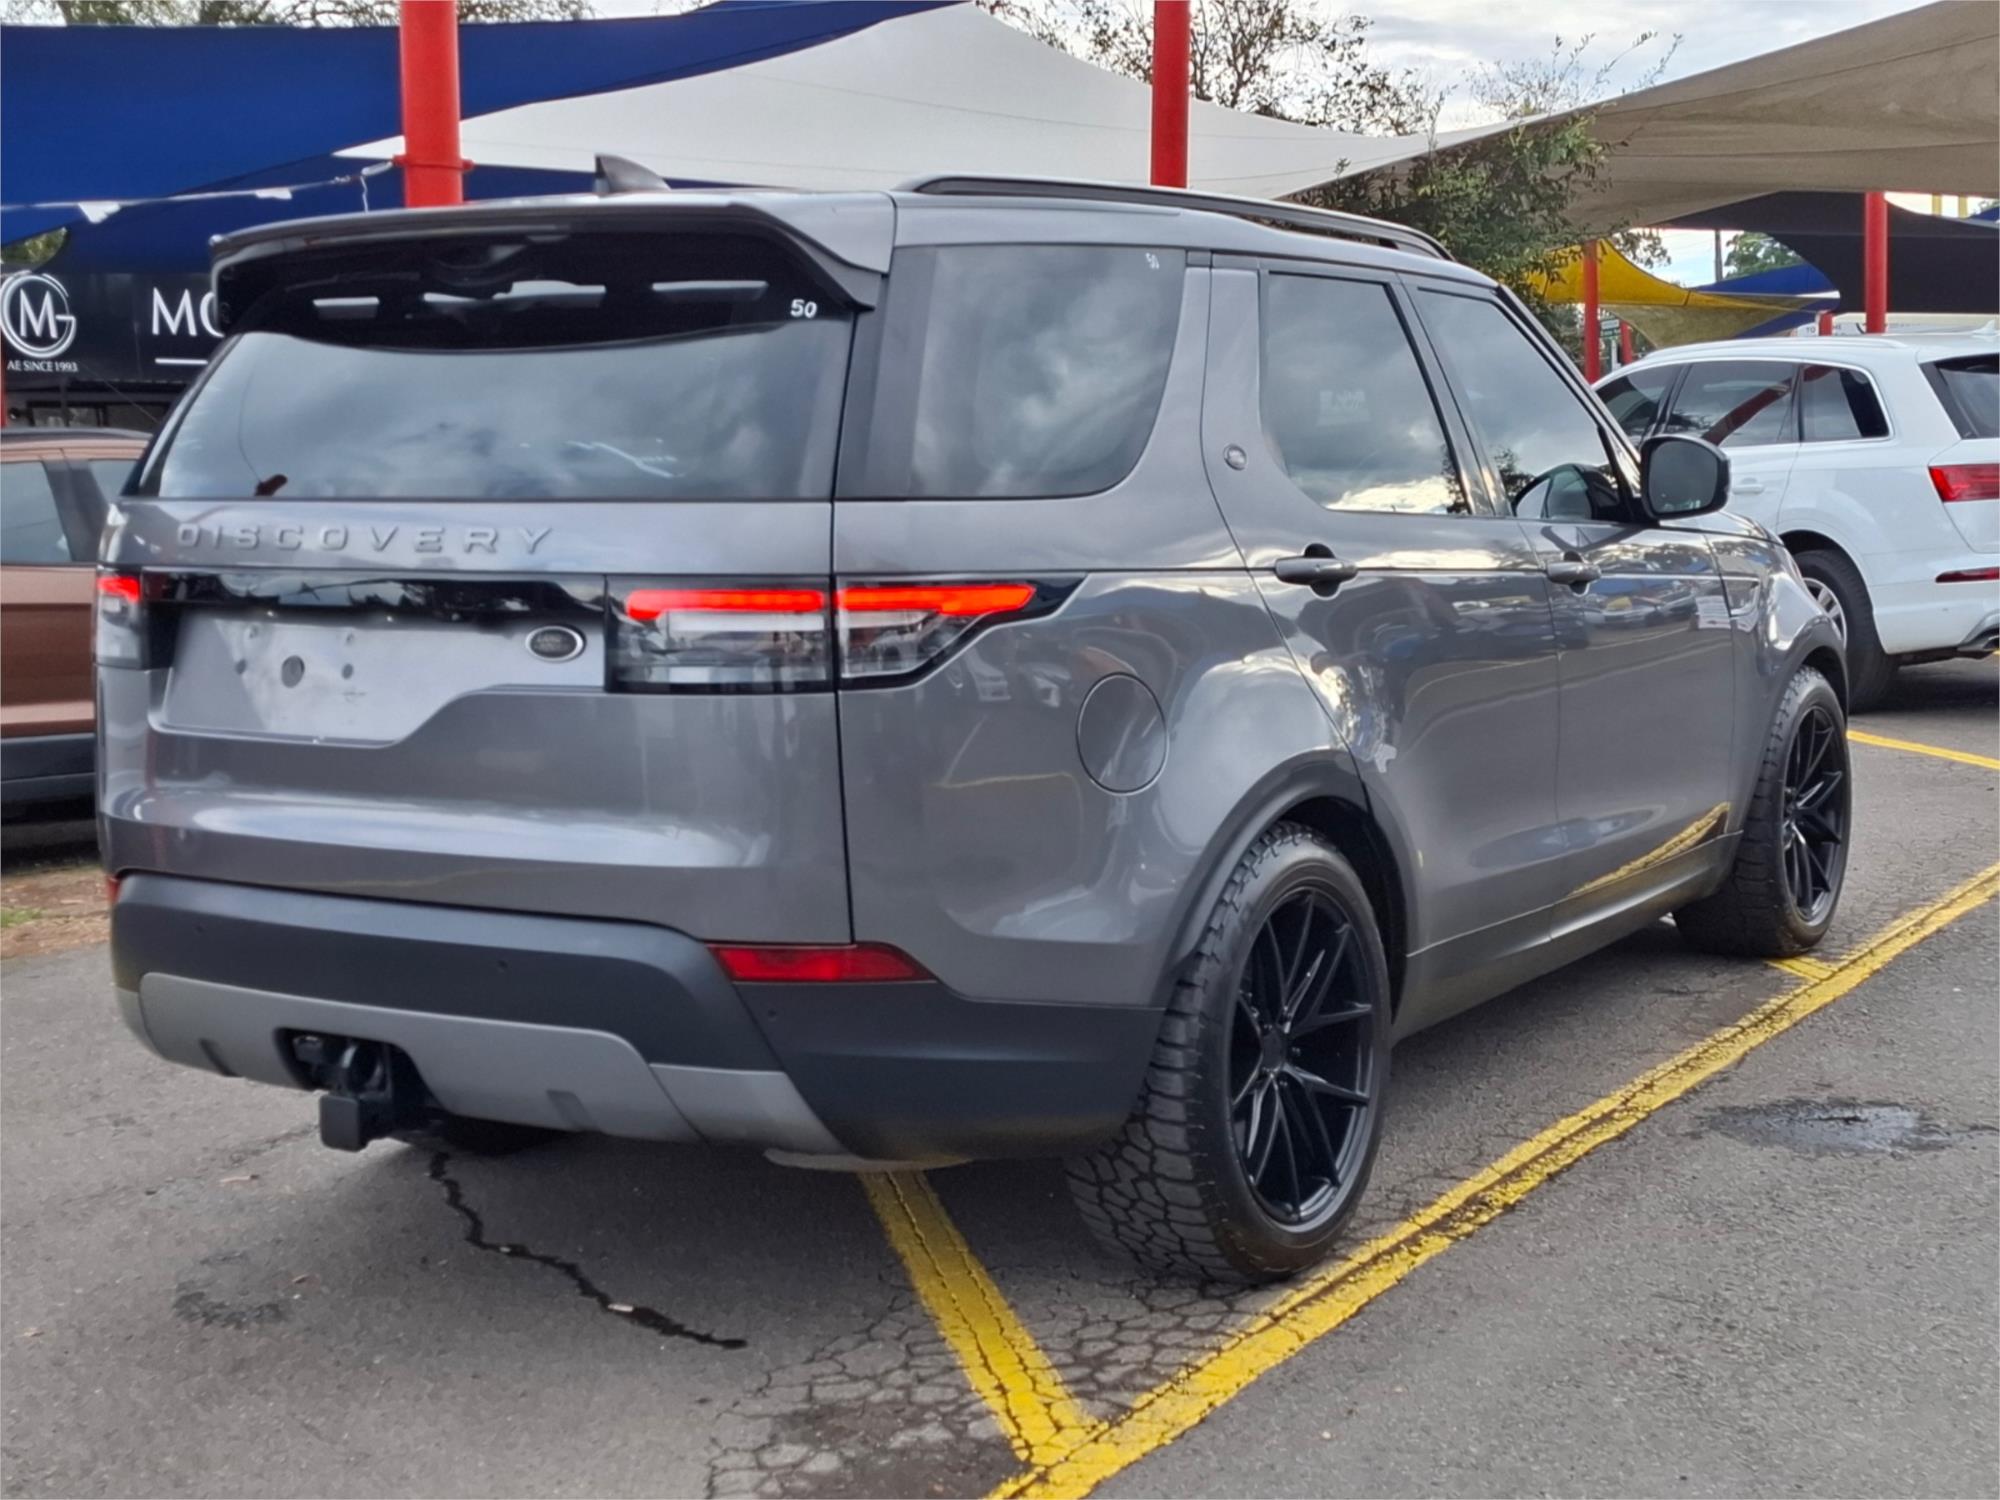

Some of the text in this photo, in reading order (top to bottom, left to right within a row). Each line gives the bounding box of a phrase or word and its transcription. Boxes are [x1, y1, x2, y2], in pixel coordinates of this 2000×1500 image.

[789, 298, 819, 319] 50
[22, 360, 54, 372] SINCE
[54, 361, 79, 373] 1993
[175, 521, 555, 556] DISCOVERY
